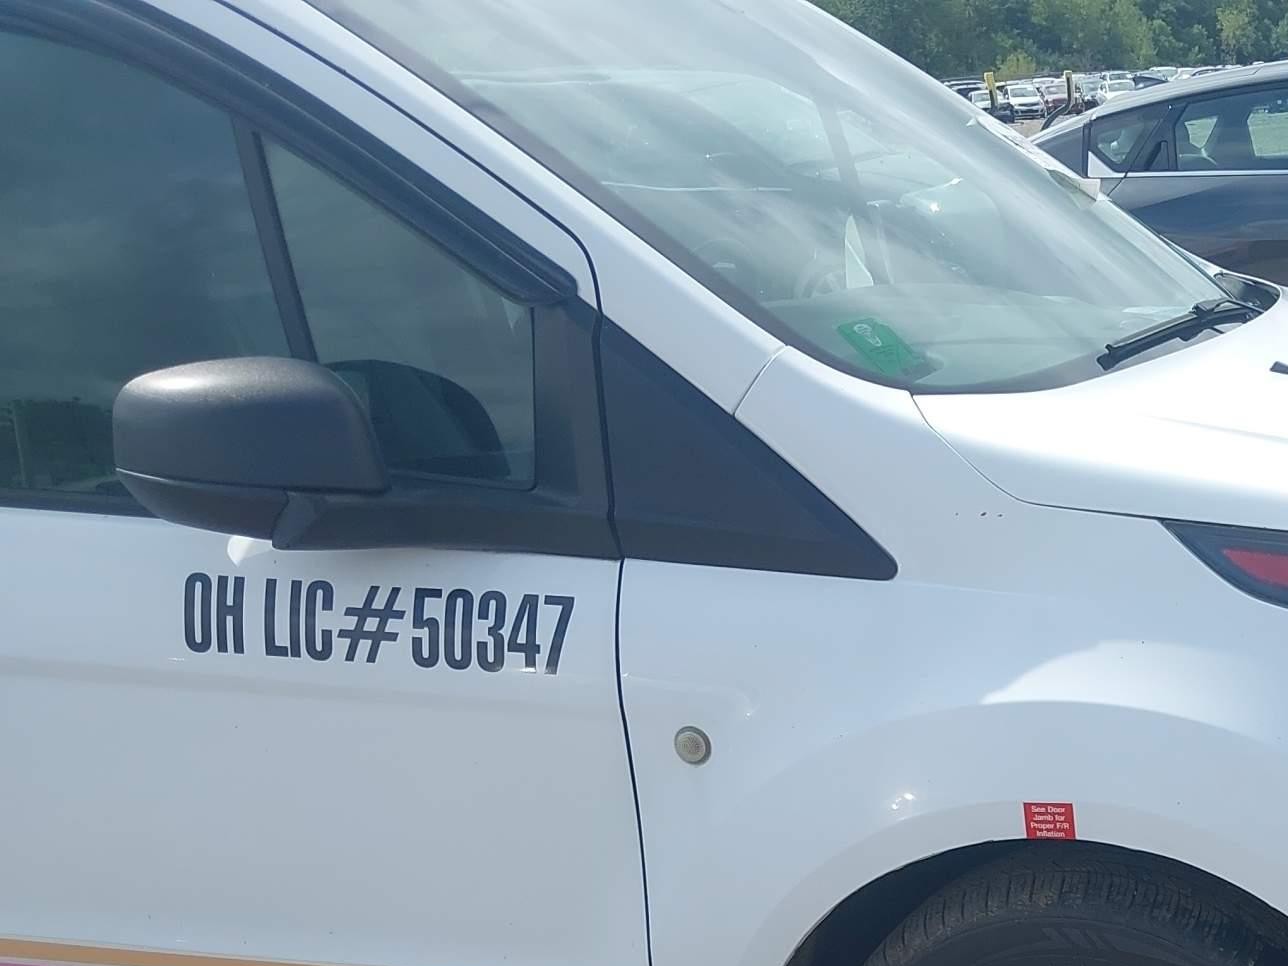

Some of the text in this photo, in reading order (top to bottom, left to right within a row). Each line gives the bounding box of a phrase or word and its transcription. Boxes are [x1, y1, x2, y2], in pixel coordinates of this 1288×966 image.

[183, 571, 576, 677] OH LIC#50347
[1031, 805, 1066, 813] See Door
[1030, 821, 1055, 830] Proper
[1036, 830, 1066, 838] Inflation
